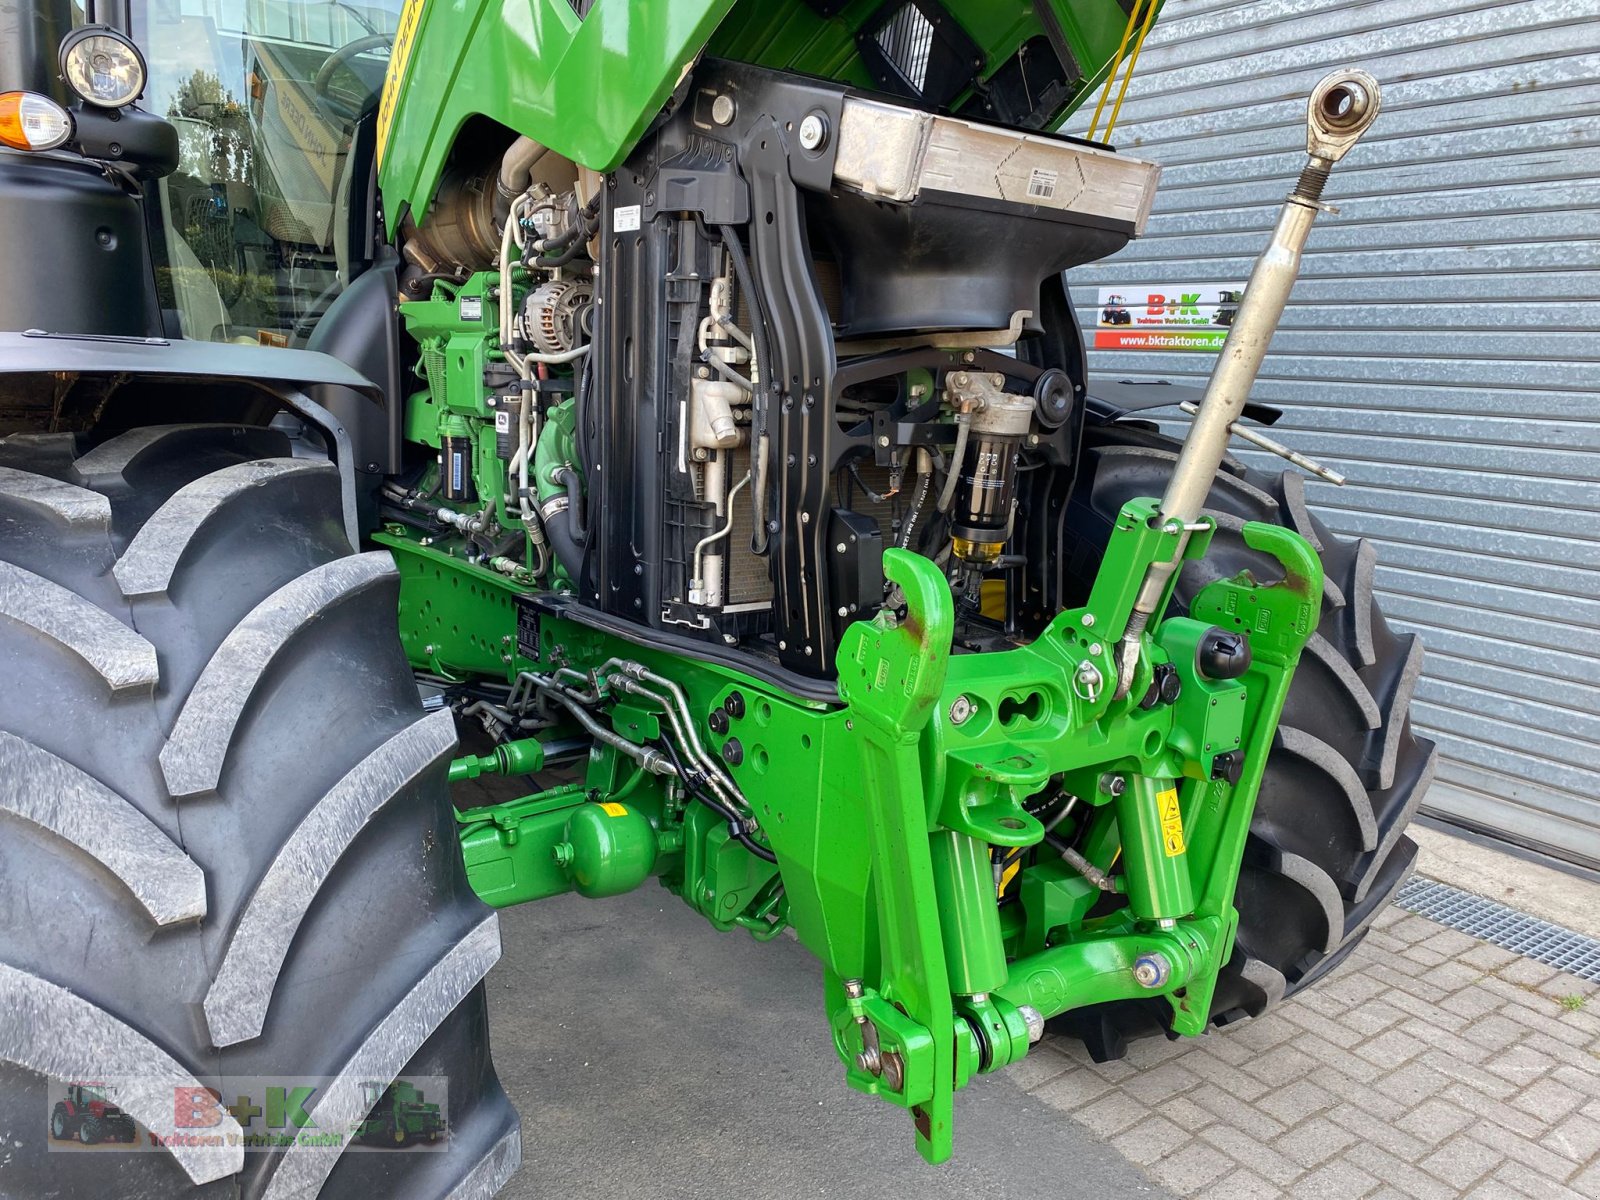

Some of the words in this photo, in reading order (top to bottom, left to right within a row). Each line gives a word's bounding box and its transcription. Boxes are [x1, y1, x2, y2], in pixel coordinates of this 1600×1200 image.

[381, 64, 398, 138] JOHN
[1147, 293, 1201, 315] B+K
[1120, 335, 1224, 347] www.bktraktoren.de
